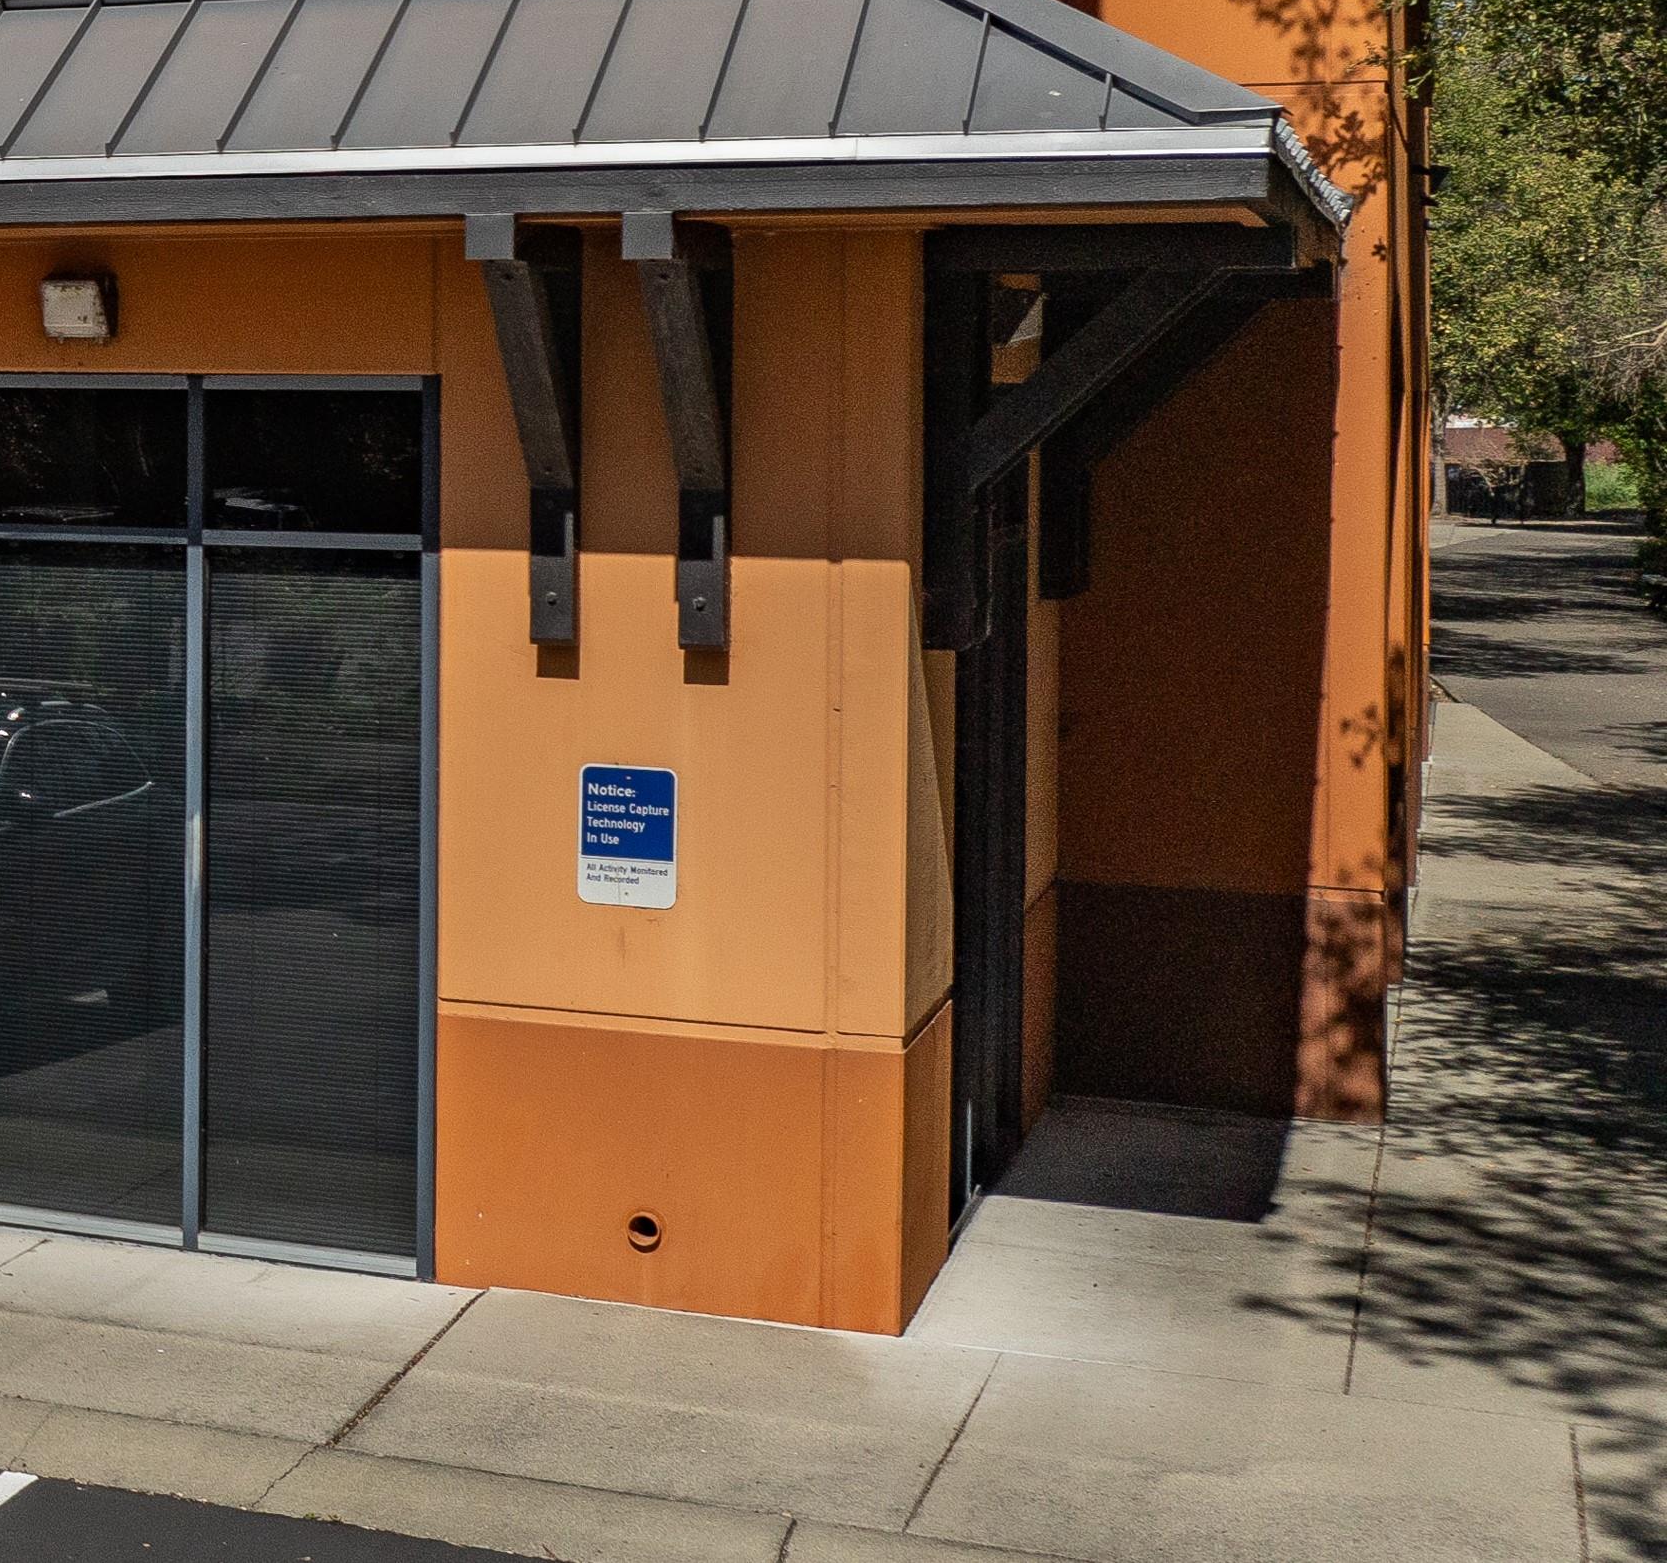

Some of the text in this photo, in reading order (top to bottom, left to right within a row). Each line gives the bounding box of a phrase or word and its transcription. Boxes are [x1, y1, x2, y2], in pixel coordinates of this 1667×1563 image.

[588, 783, 636, 797] Notice:
[587, 801, 670, 817] License Capture
[587, 816, 646, 833] Technology
[586, 833, 620, 844] In Use
[587, 863, 668, 876] All Activity Monitored
[587, 873, 640, 884] And Recorded
